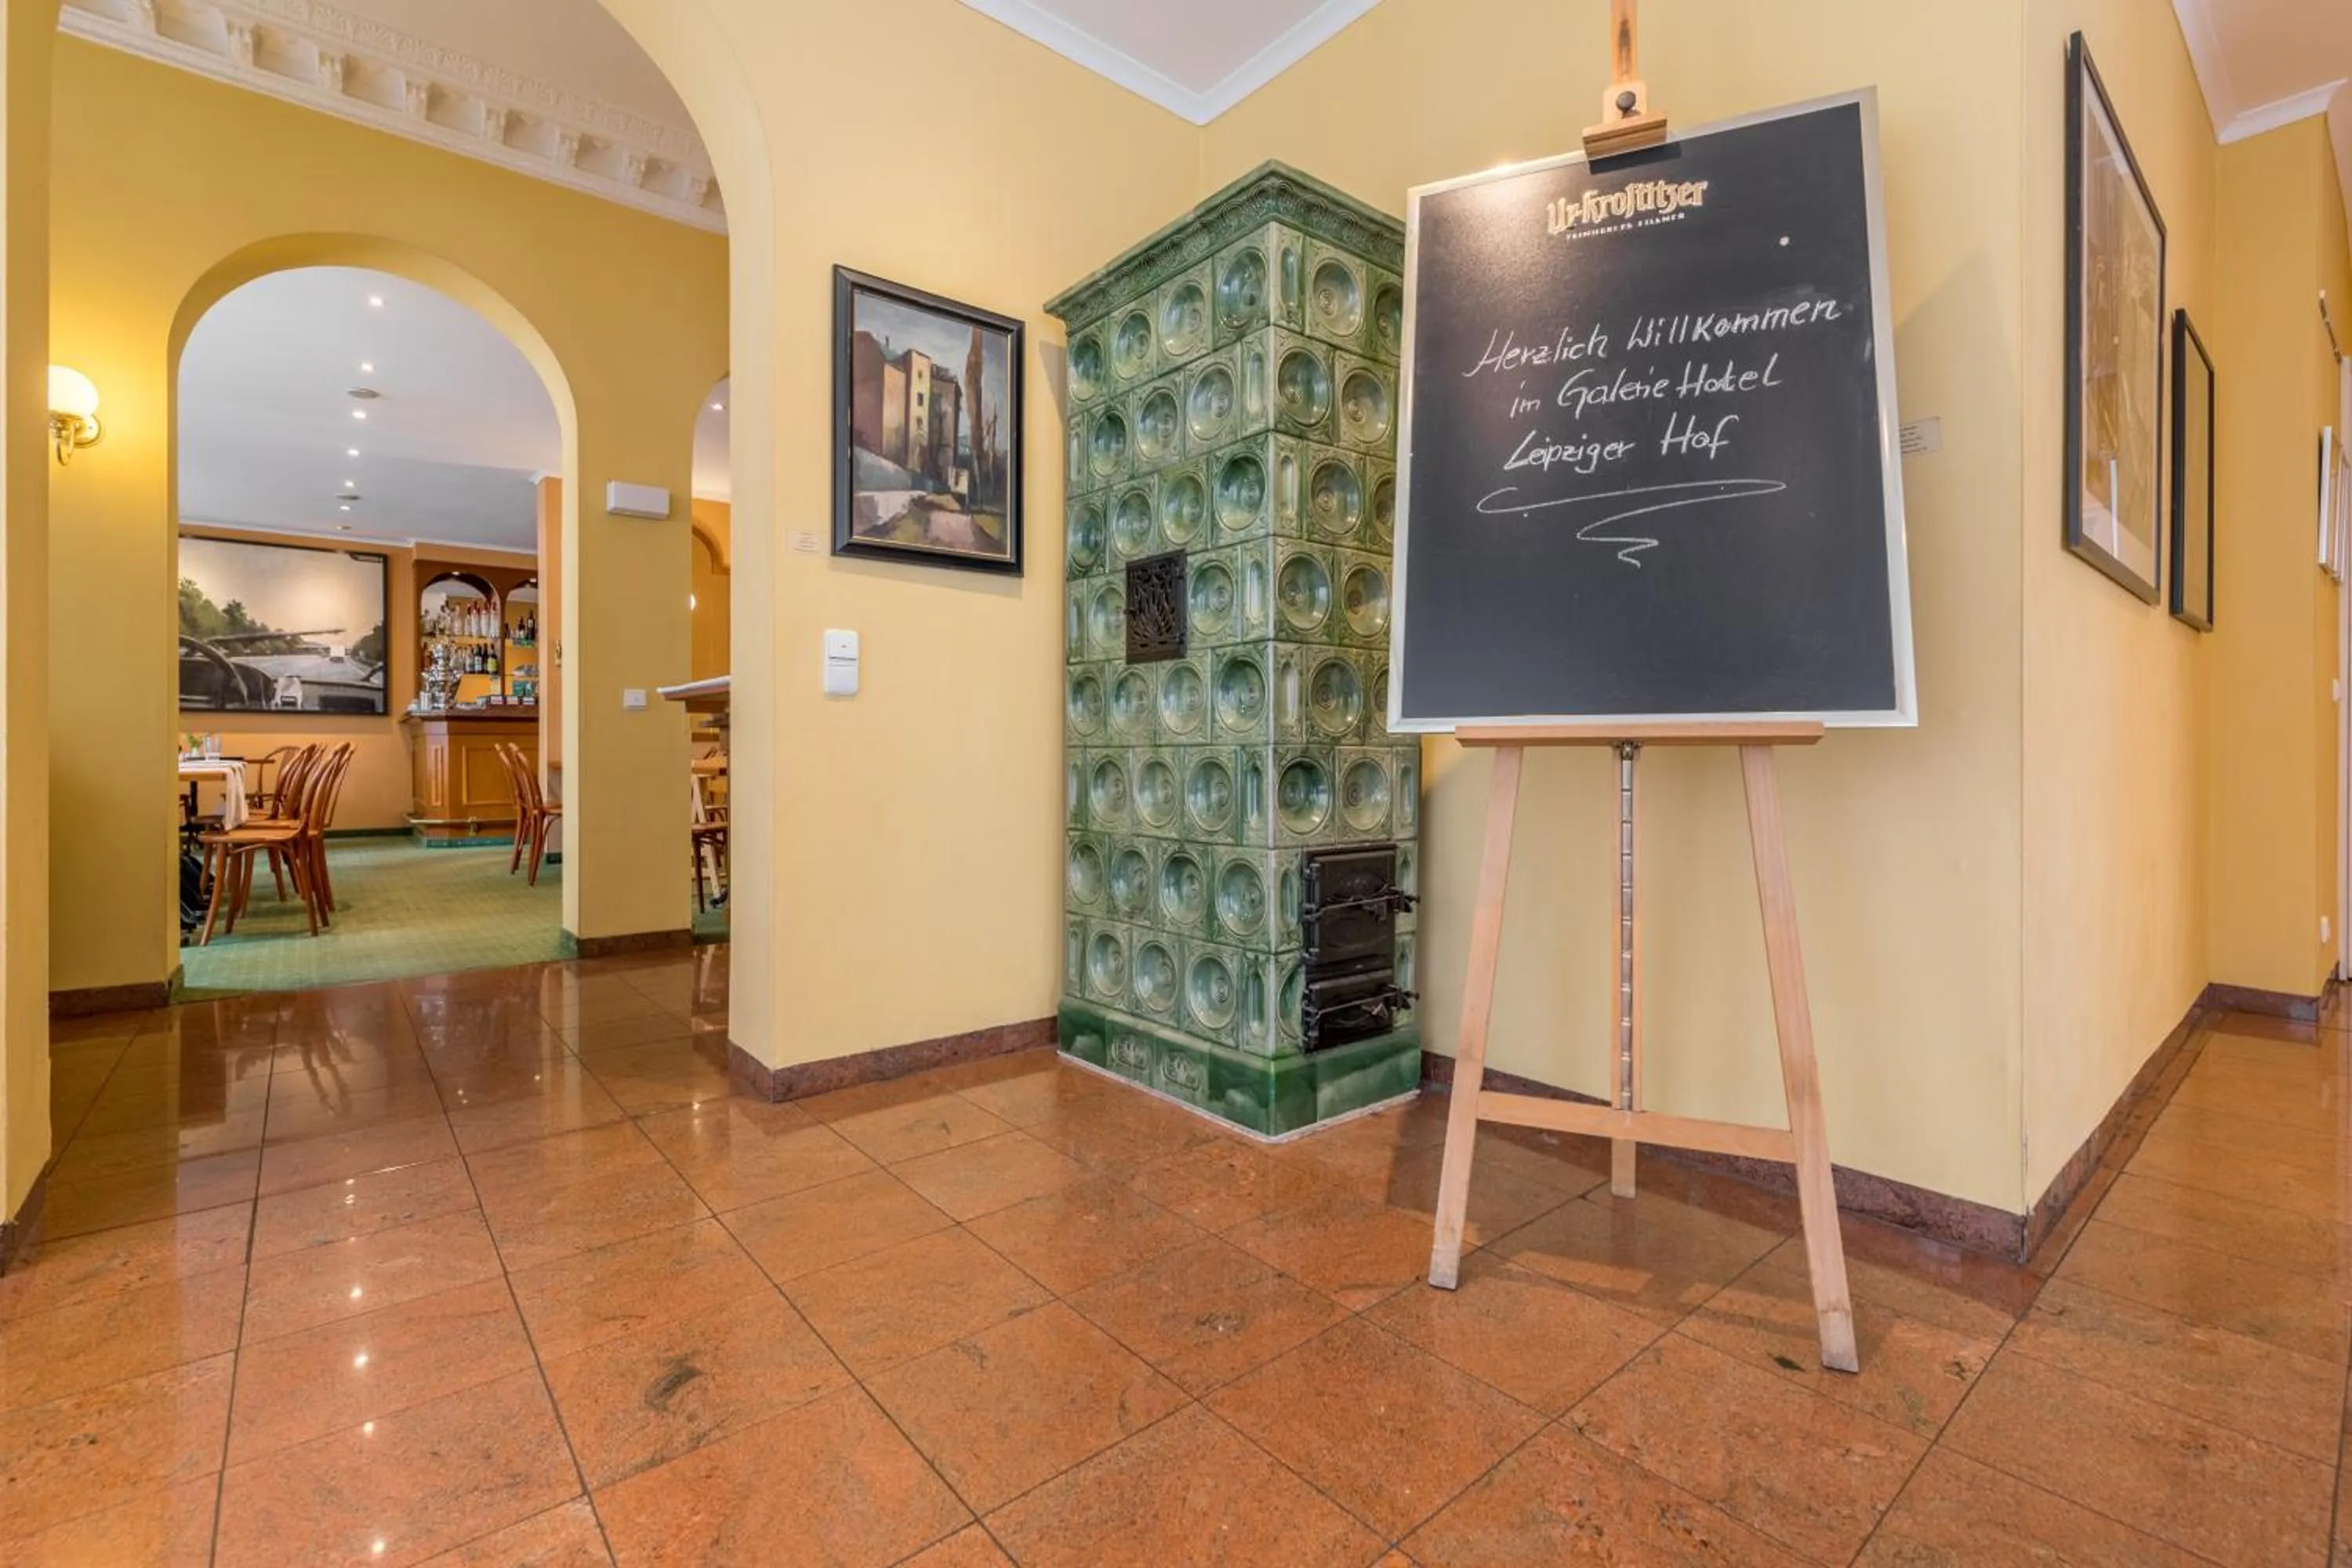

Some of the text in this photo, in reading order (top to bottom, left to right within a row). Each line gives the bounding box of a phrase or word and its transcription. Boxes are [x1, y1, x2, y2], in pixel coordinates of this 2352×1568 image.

[1463, 323, 1609, 377] Herzlich
[1510, 353, 1783, 419] im Galerie Hotel
[1504, 412, 1740, 474] Leipziger Hof
